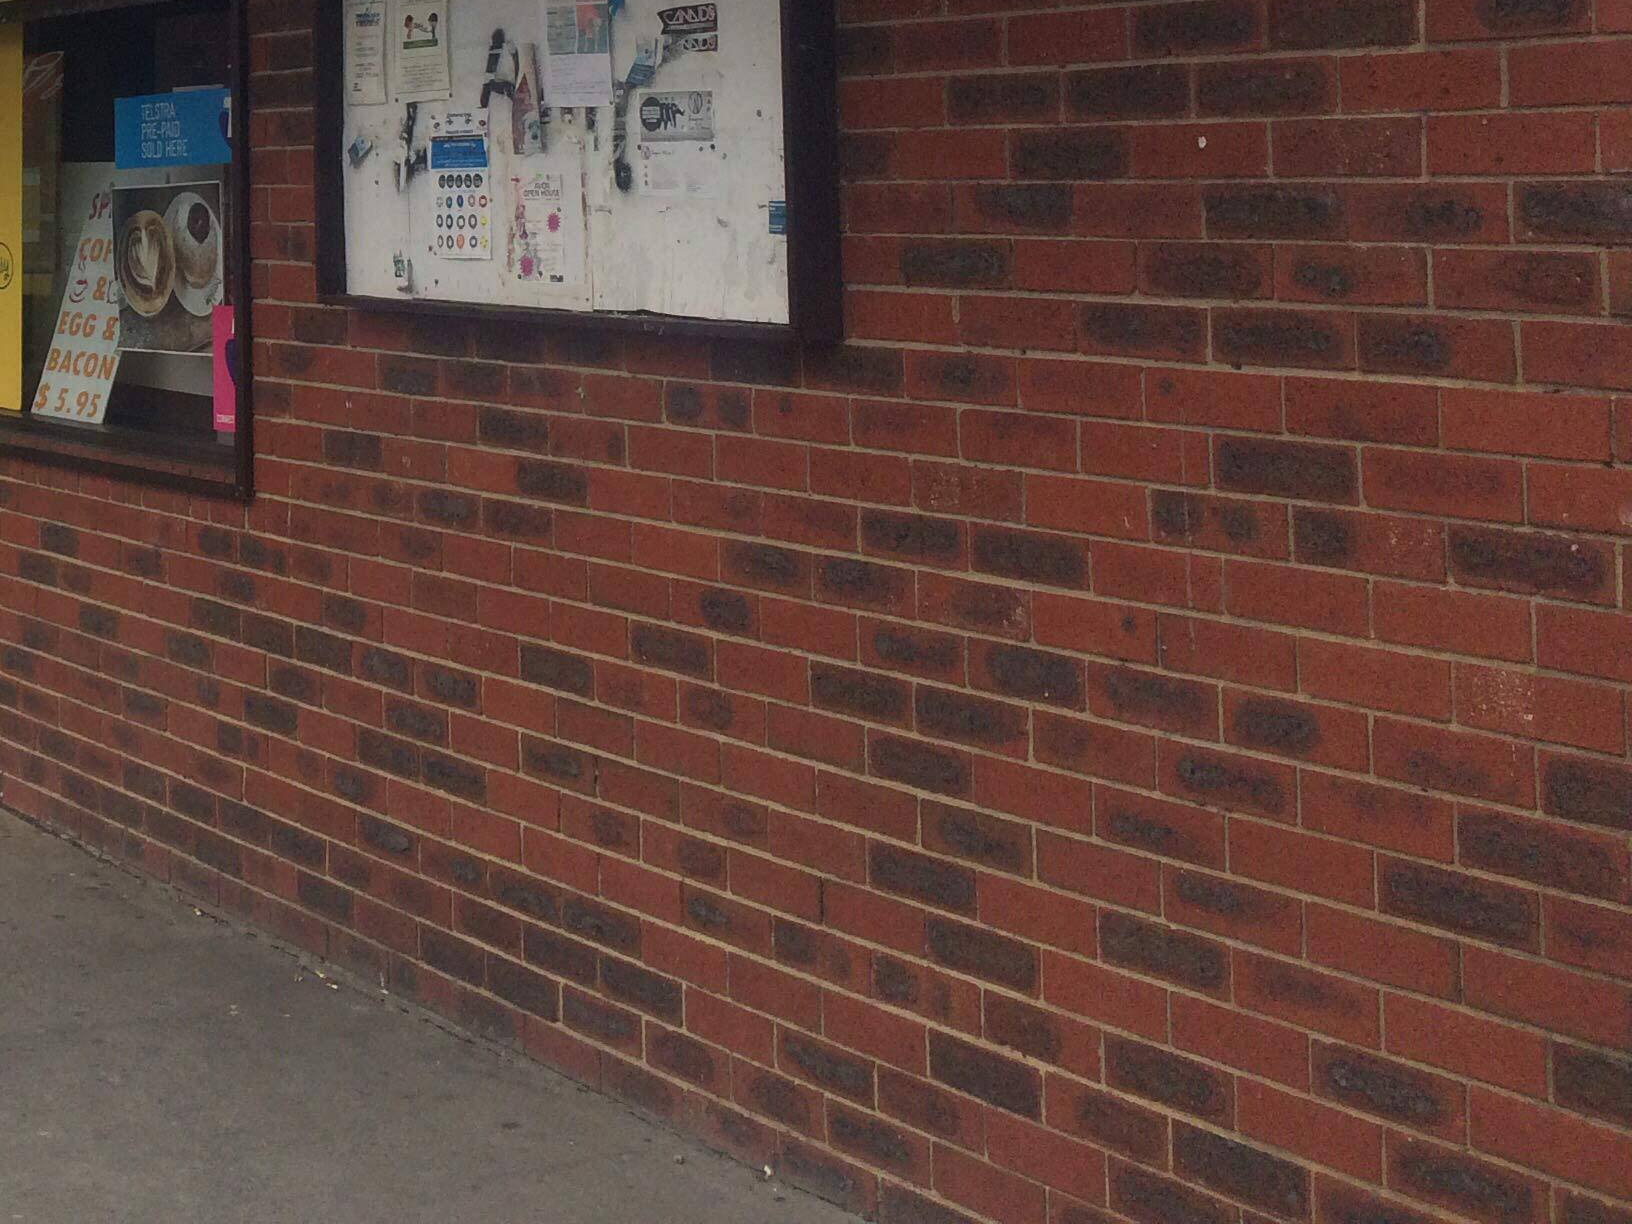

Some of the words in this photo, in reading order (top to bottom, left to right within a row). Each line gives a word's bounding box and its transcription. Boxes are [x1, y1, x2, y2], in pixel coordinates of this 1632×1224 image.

[140, 102, 177, 121] TELSTRA
[140, 121, 181, 140] PRE-PAID
[141, 140, 163, 159] SOLD
[165, 139, 188, 158] HERE
[57, 310, 97, 339] EGG
[45, 347, 118, 381] BACON
[34, 381, 51, 411] $
[54, 387, 102, 418] 5.95
